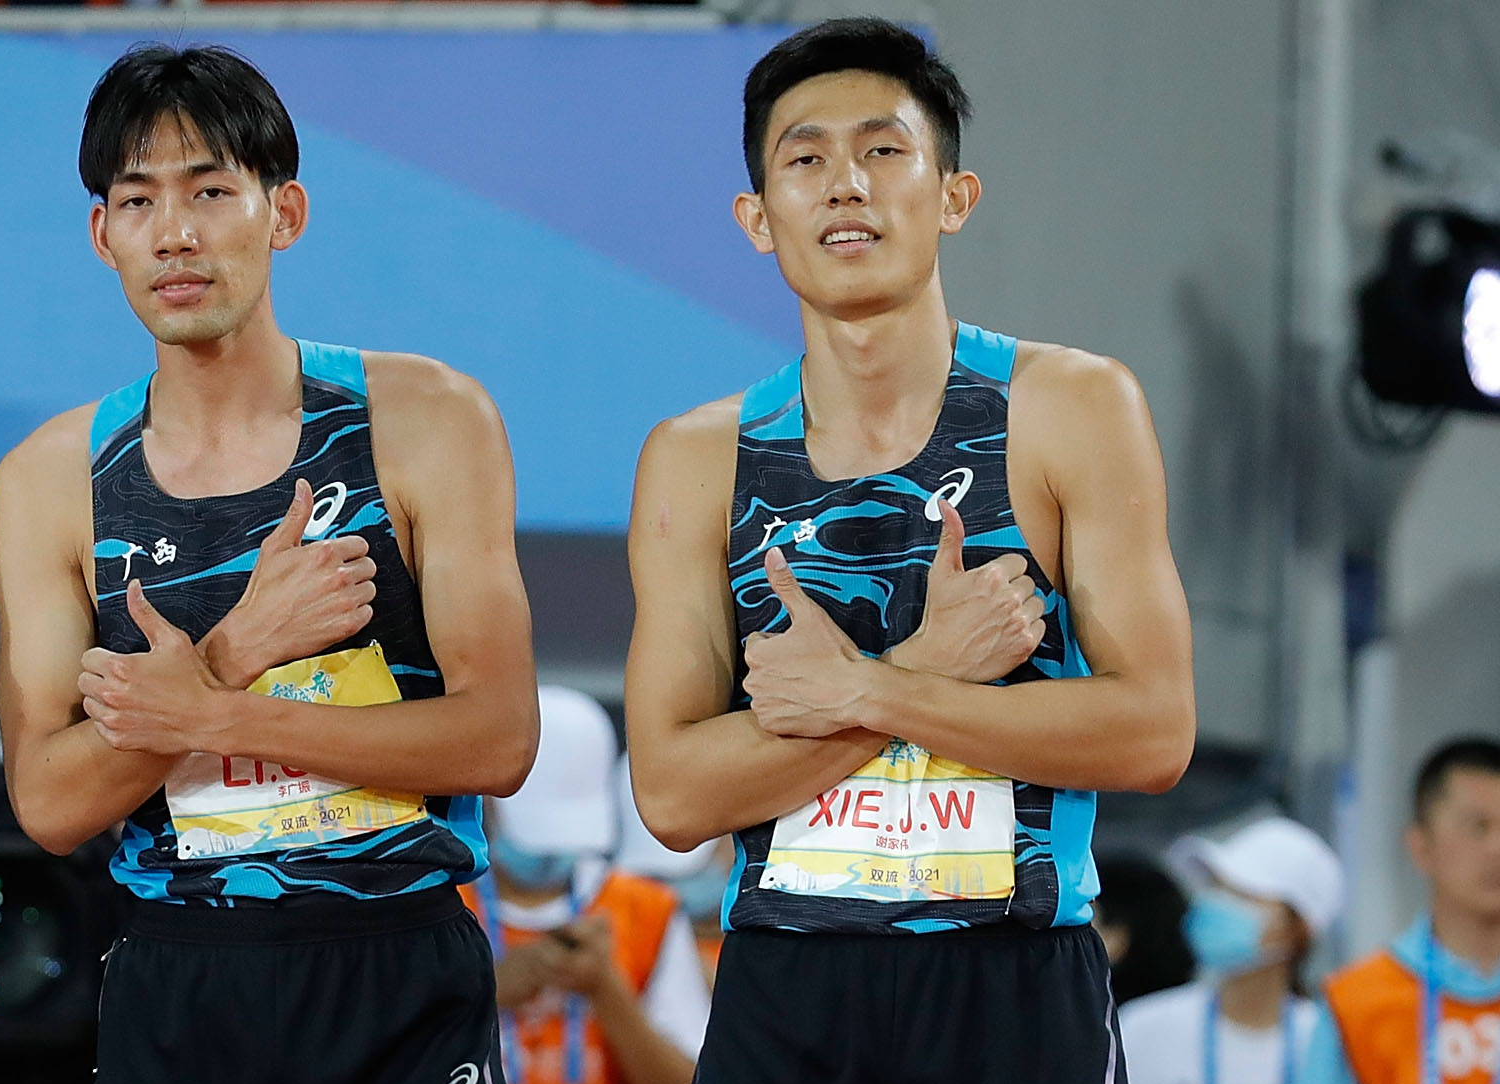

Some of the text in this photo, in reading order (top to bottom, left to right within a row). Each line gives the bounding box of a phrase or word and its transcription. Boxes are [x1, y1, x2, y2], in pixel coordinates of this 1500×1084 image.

[758, 515, 817, 551] 广西
[121, 537, 177, 582] 广西
[221, 756, 309, 788] LI.
[808, 788, 976, 834] XIE.J.W
